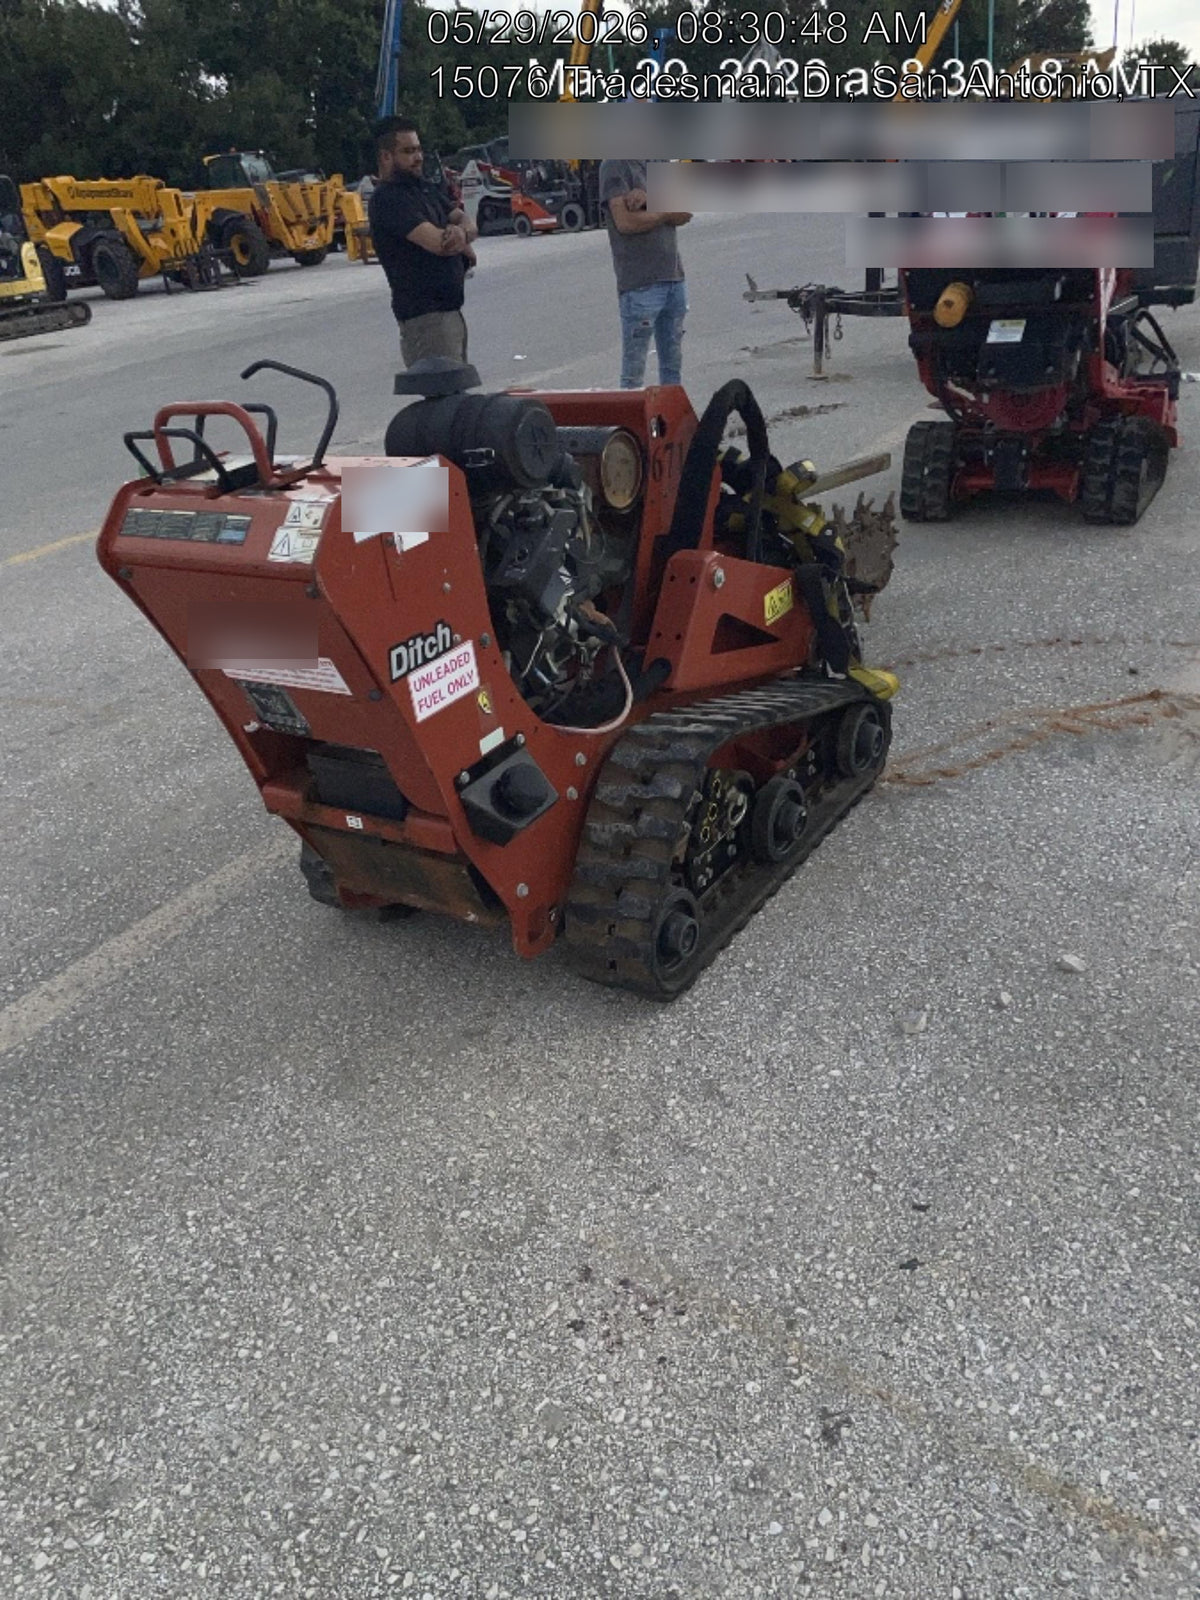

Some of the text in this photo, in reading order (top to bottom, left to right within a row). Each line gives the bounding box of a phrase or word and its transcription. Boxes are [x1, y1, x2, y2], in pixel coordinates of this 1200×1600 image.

[390, 622, 451, 680] Ditch
[413, 651, 471, 693] UNLEADED
[417, 669, 475, 713] FUEL ONLY
